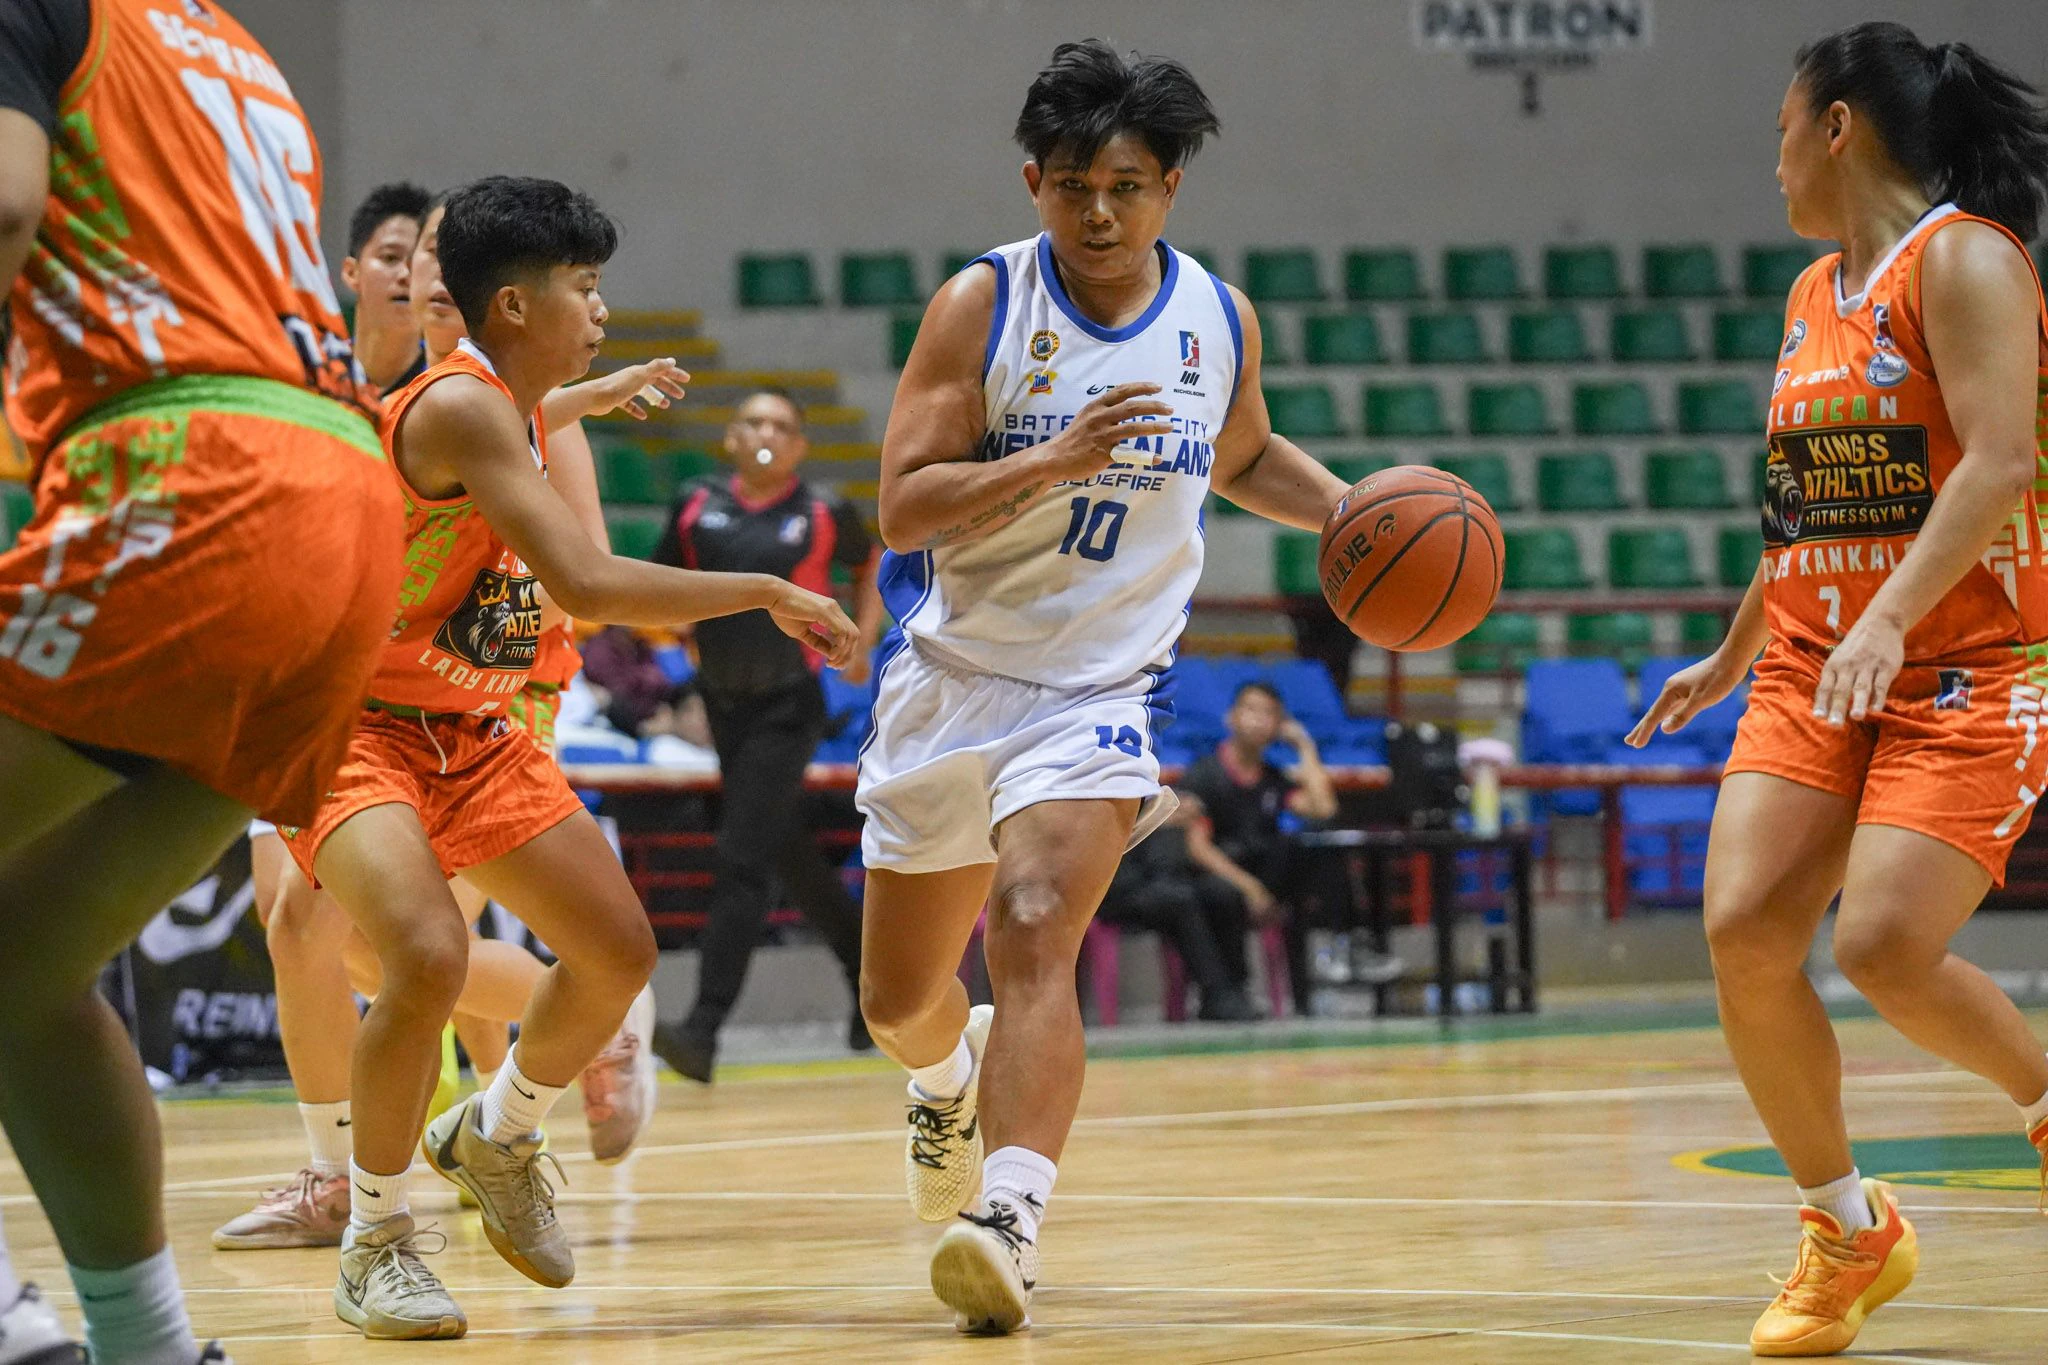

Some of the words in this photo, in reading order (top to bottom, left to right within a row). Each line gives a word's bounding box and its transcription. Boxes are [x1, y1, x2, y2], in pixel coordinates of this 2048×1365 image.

[1420, 1, 1641, 39] PATRON
[178, 68, 342, 316] 16
[1806, 433, 1890, 465] KINGS
[1803, 462, 1927, 502] ATHLTICS
[1059, 496, 1129, 562] 10
[1800, 540, 1915, 576] KANKAL
[1819, 586, 1841, 631] 7
[0, 582, 97, 681] 16
[418, 649, 484, 690] LADY
[1096, 725, 1142, 758] 10
